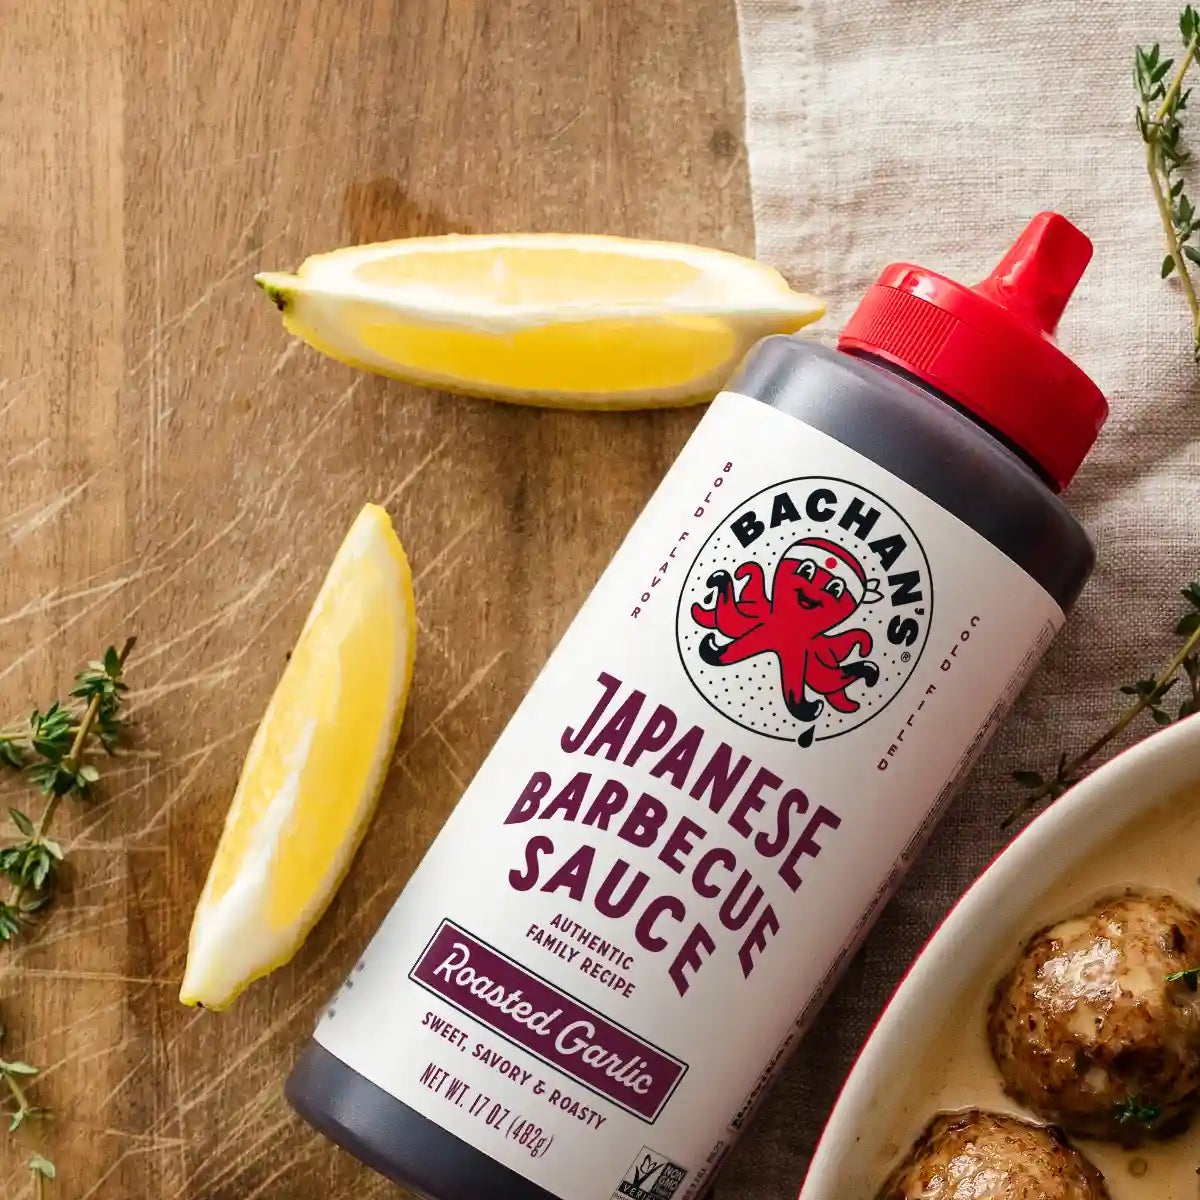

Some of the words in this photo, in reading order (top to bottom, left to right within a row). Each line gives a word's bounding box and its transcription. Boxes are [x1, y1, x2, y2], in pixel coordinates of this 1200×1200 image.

[694, 461, 733, 518] BOLD
[631, 531, 689, 619] FLAVOR
[730, 488, 925, 647] BACHAN'S
[940, 616, 980, 671] COLD
[877, 684, 936, 771] FILLED
[561, 672, 841, 893] JAPANESE
[503, 771, 780, 980] BARBECUE
[508, 835, 716, 998] SAUCE
[526, 924, 581, 963] FAMILY
[580, 956, 636, 998] RECIPE
[550, 913, 634, 970] AUTHENTIC
[433, 942, 563, 1035] Roasted
[554, 1020, 653, 1094] Garlic
[419, 1062, 444, 1093] NET
[443, 1077, 470, 1108] WT.
[469, 1093, 491, 1118] 17
[486, 1105, 510, 1131] OZ
[505, 1114, 555, 1158] (482g)
[422, 1012, 468, 1052] SWEET,
[472, 1043, 533, 1086] SAVORY
[533, 1080, 546, 1095] &
[548, 1089, 607, 1130] ROASTY
[658, 1176, 680, 1191] GMO
[664, 1167, 684, 1180] NON
